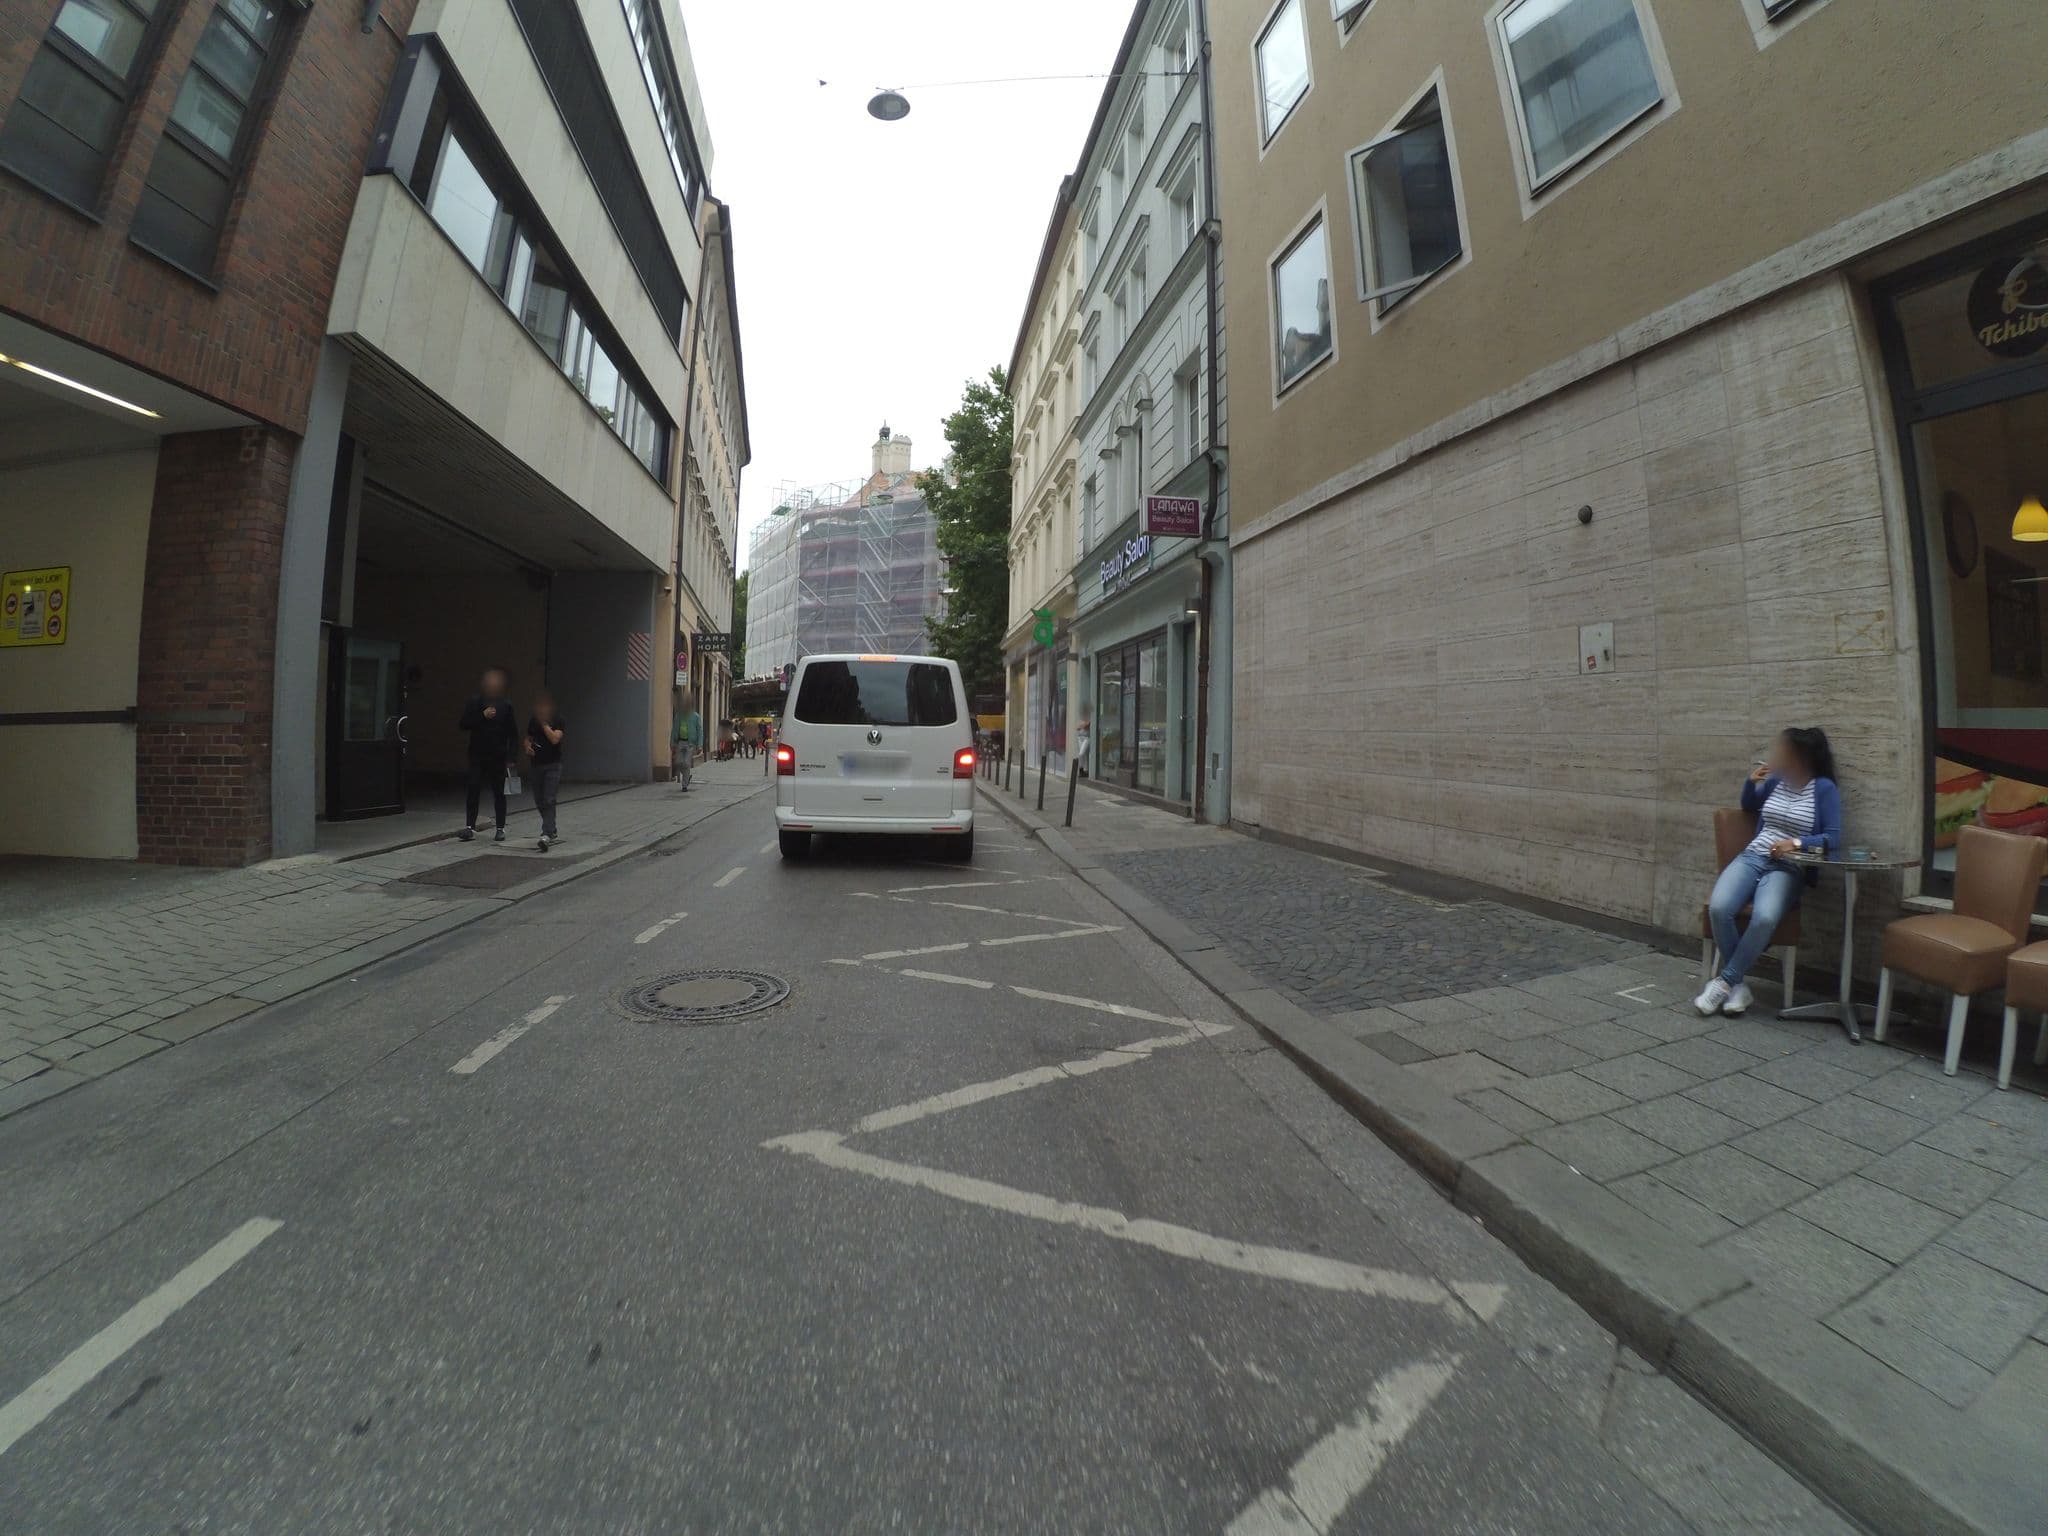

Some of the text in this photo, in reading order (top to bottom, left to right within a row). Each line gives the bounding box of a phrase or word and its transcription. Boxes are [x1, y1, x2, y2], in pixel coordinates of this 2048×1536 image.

[1151, 499, 1195, 513] LANAWA
[1152, 514, 1195, 525] Beauty Salon
[1100, 549, 1124, 584] Beauty
[1125, 532, 1150, 567] Salon
